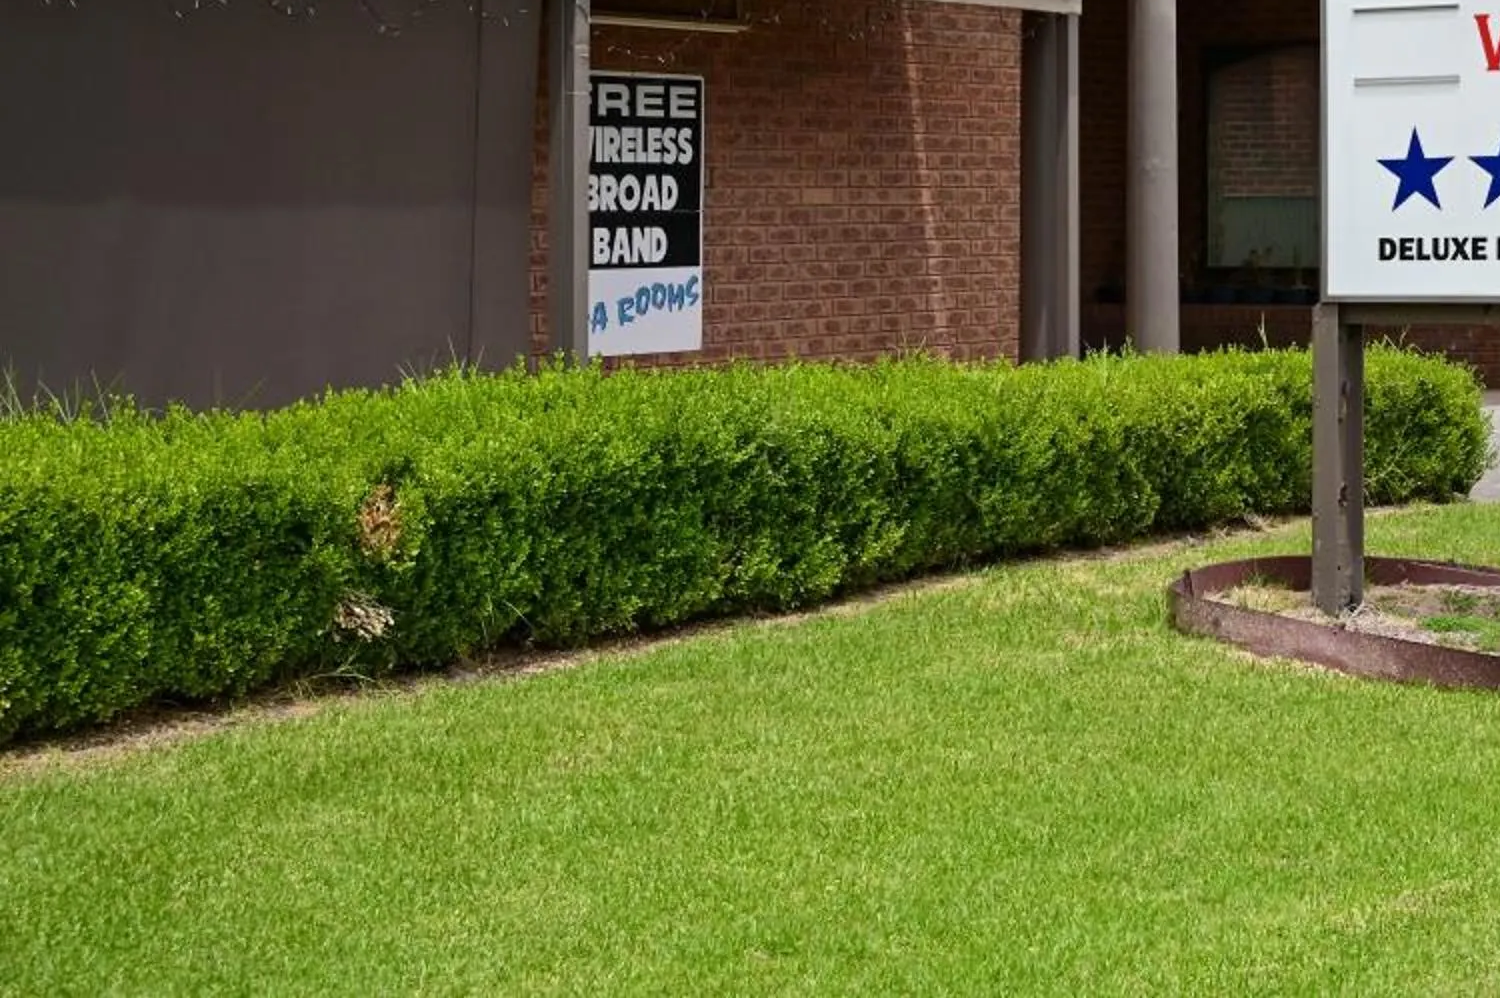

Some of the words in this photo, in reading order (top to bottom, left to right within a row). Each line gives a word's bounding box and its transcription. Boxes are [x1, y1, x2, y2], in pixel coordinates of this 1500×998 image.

[589, 83, 697, 119] REE
[588, 126, 693, 165] IRELESS
[593, 227, 668, 265] BAND
[1378, 237, 1488, 261] DELUXE
[617, 275, 699, 327] ROOMS
